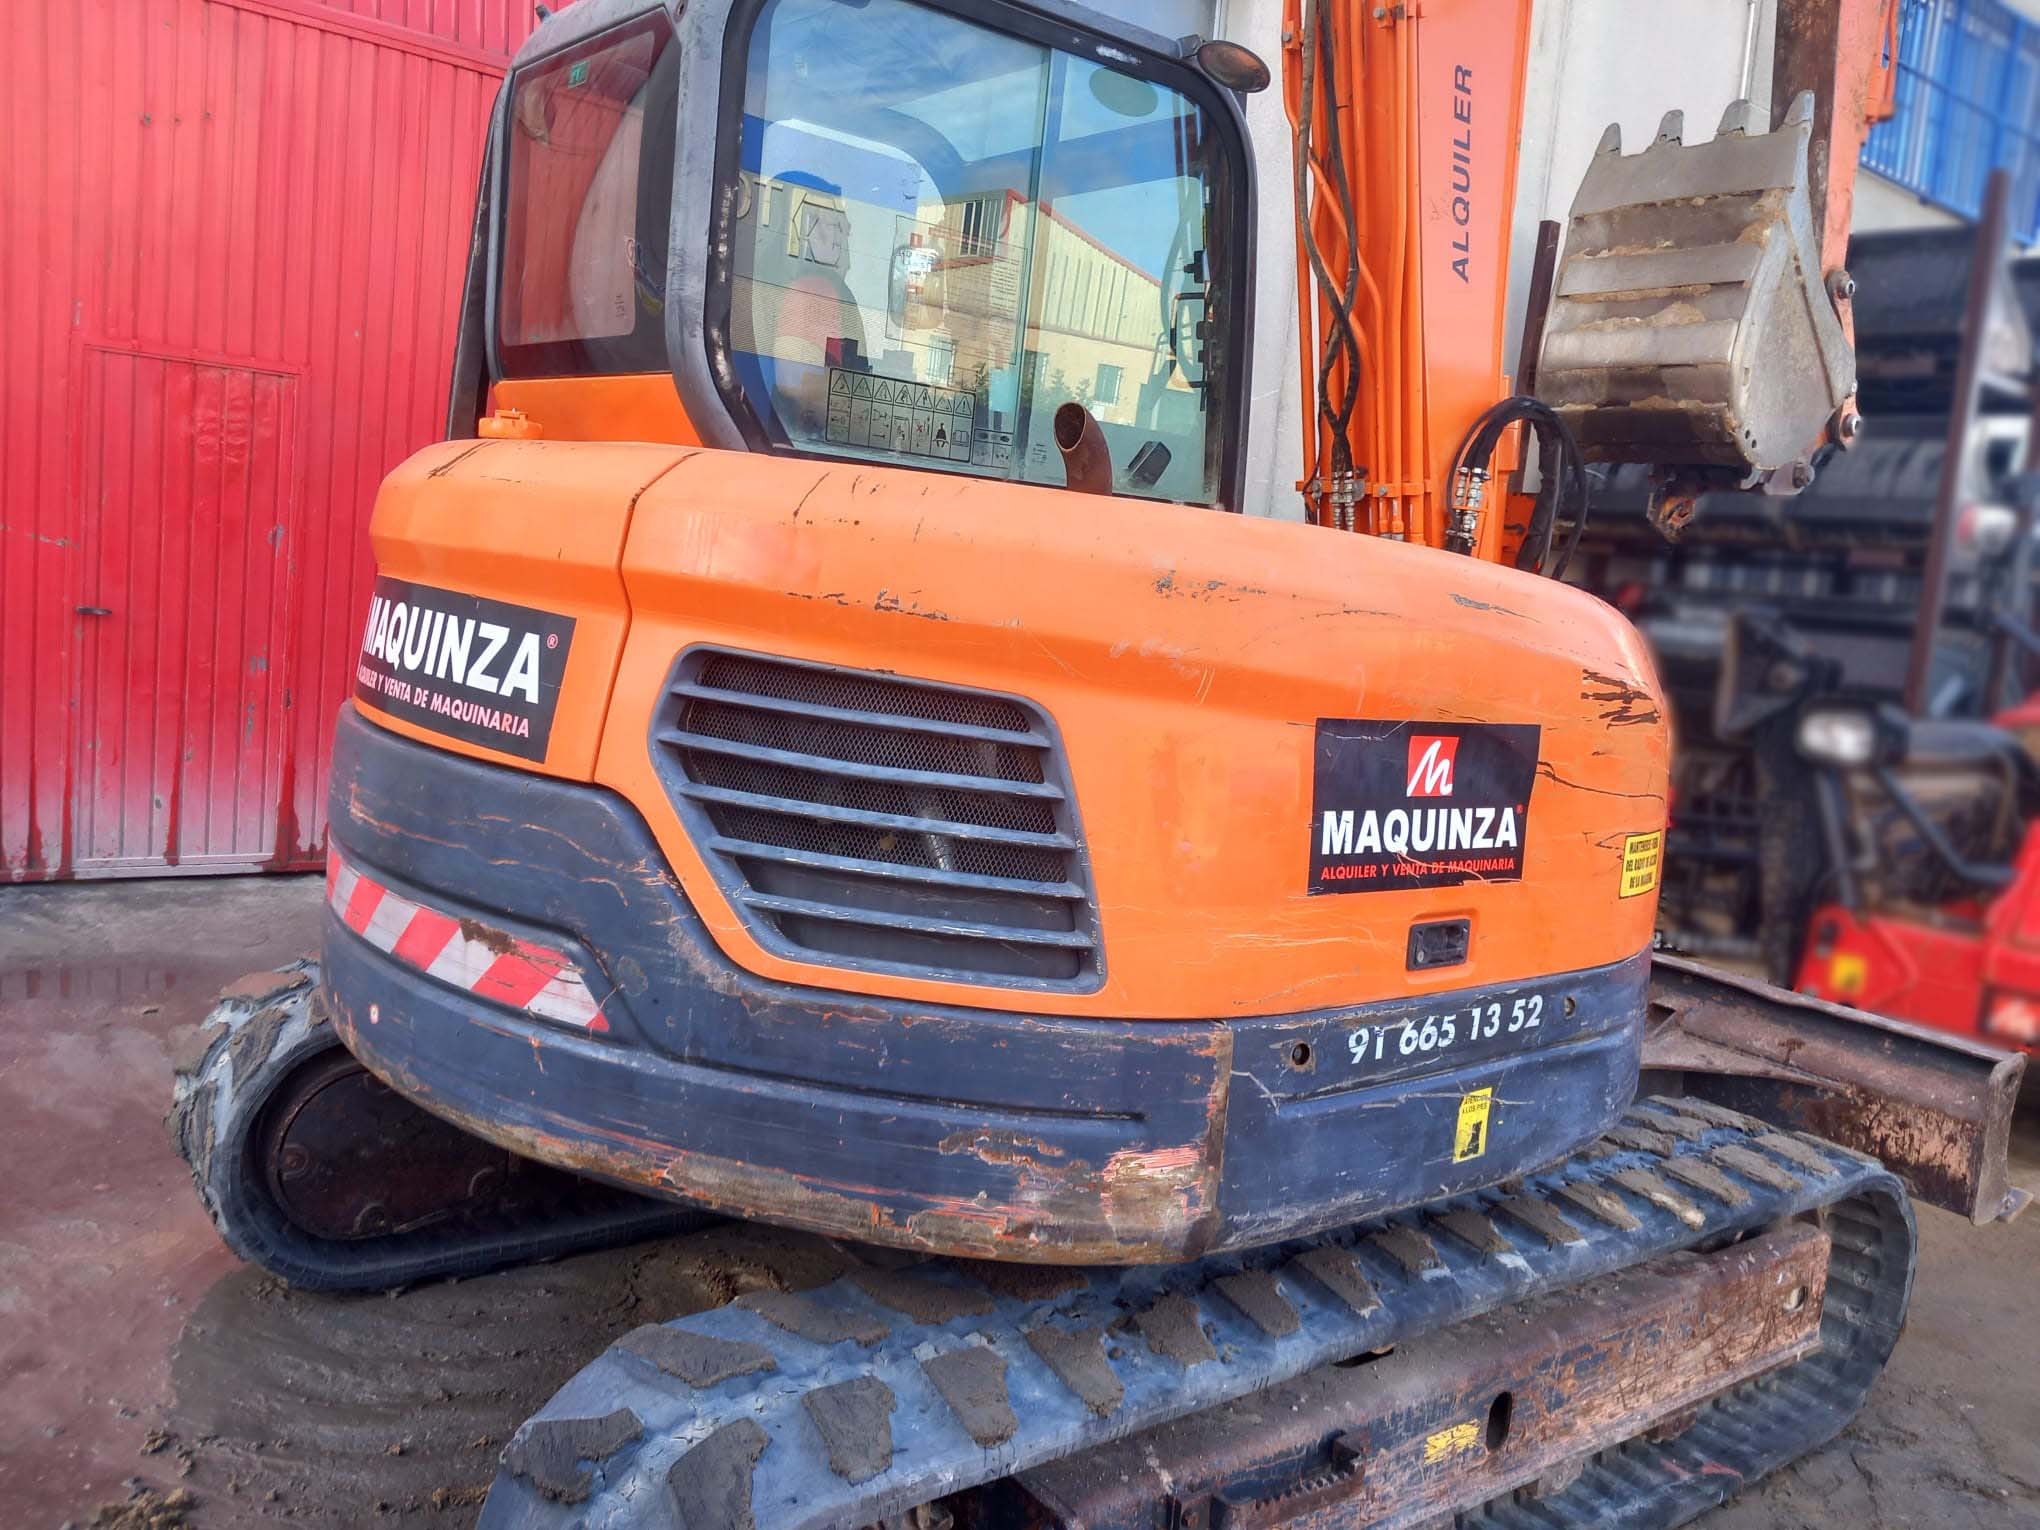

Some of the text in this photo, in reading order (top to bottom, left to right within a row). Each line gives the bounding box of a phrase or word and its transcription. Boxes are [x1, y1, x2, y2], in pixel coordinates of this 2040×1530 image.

[1452, 64, 1473, 283] ALQUILER
[364, 595, 540, 704] MAQUINZA
[378, 674, 385, 692] Y
[384, 676, 411, 703] VENTA
[413, 688, 429, 708] DE
[430, 693, 529, 738] MAQUINARIA
[1321, 807, 1518, 855] MAQUINZA
[1321, 858, 1515, 880] ALQUILER Y VENTA DE MAQUINARIA
[1348, 994, 1543, 1064] 91 665 13 52
